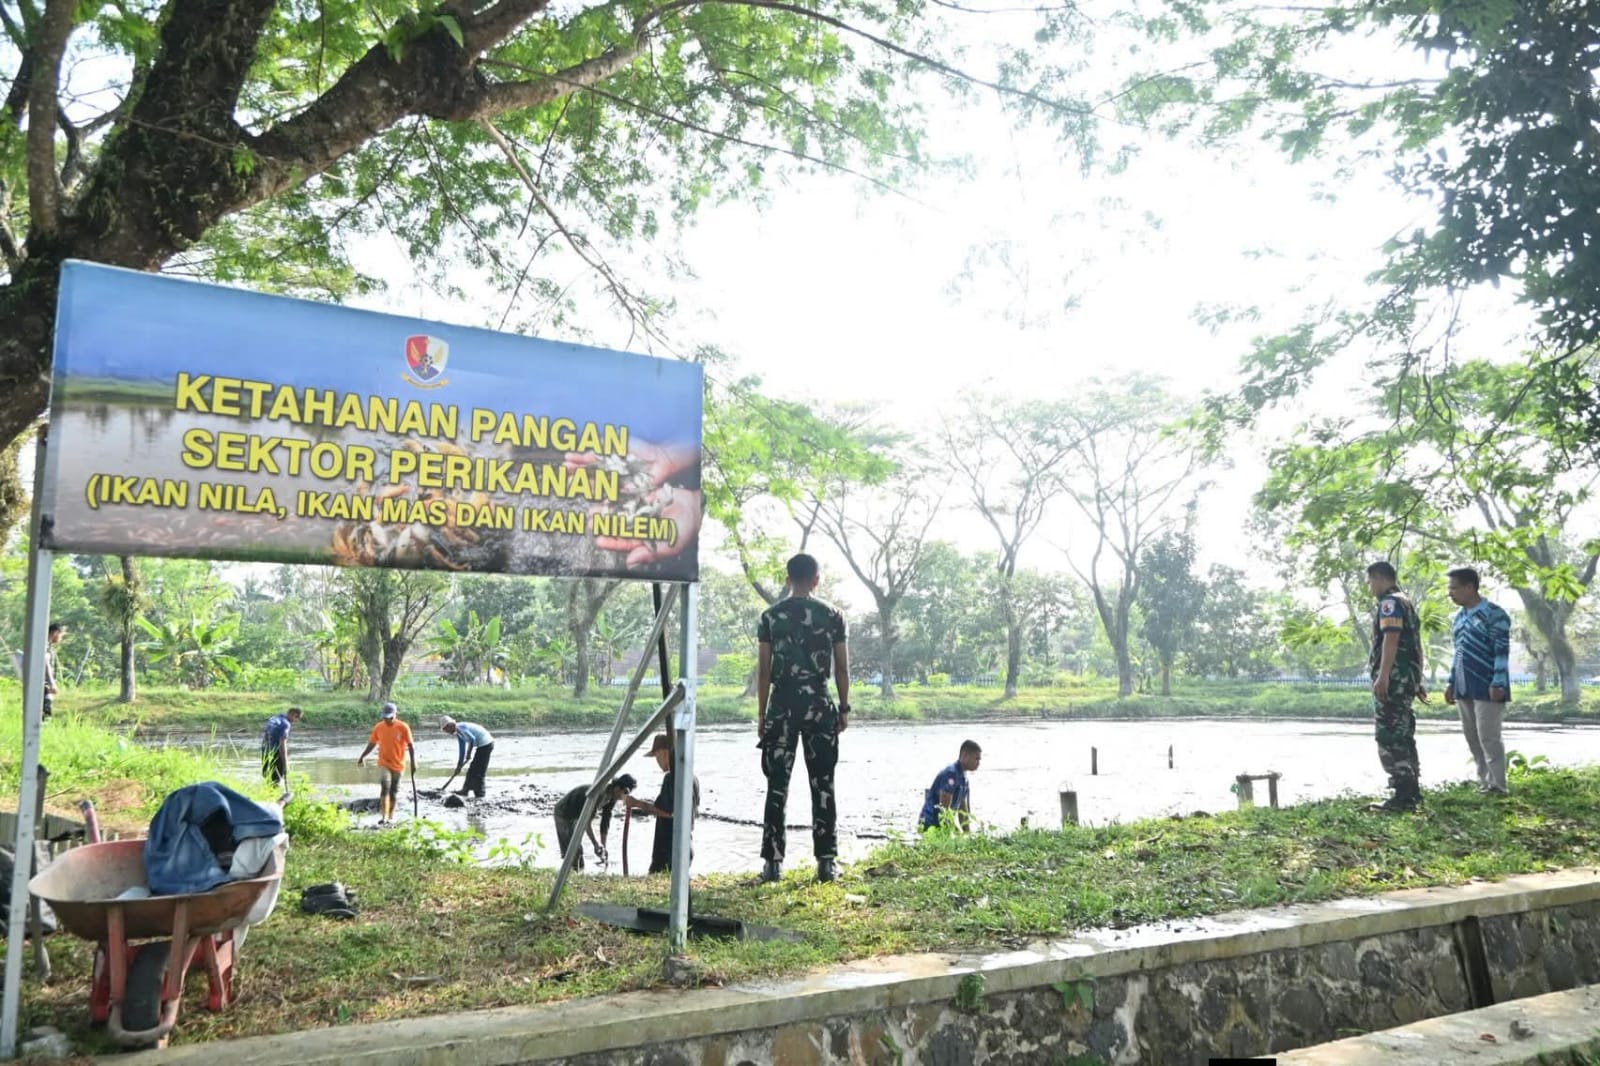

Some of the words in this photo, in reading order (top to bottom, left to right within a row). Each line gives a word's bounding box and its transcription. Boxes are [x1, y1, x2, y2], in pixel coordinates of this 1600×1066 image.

[176, 372, 458, 440] KETAHANAN
[471, 408, 628, 457] PANGAN
[182, 429, 376, 482] SEKTOR
[389, 449, 619, 501] PERIKANAN
[86, 474, 188, 508] (IKAN
[199, 483, 286, 519] NILA,
[297, 491, 373, 521] IKAN
[382, 497, 447, 526] MAS
[456, 502, 514, 530] DAN
[522, 508, 585, 534] IKAN
[592, 513, 678, 547] NILEM)
